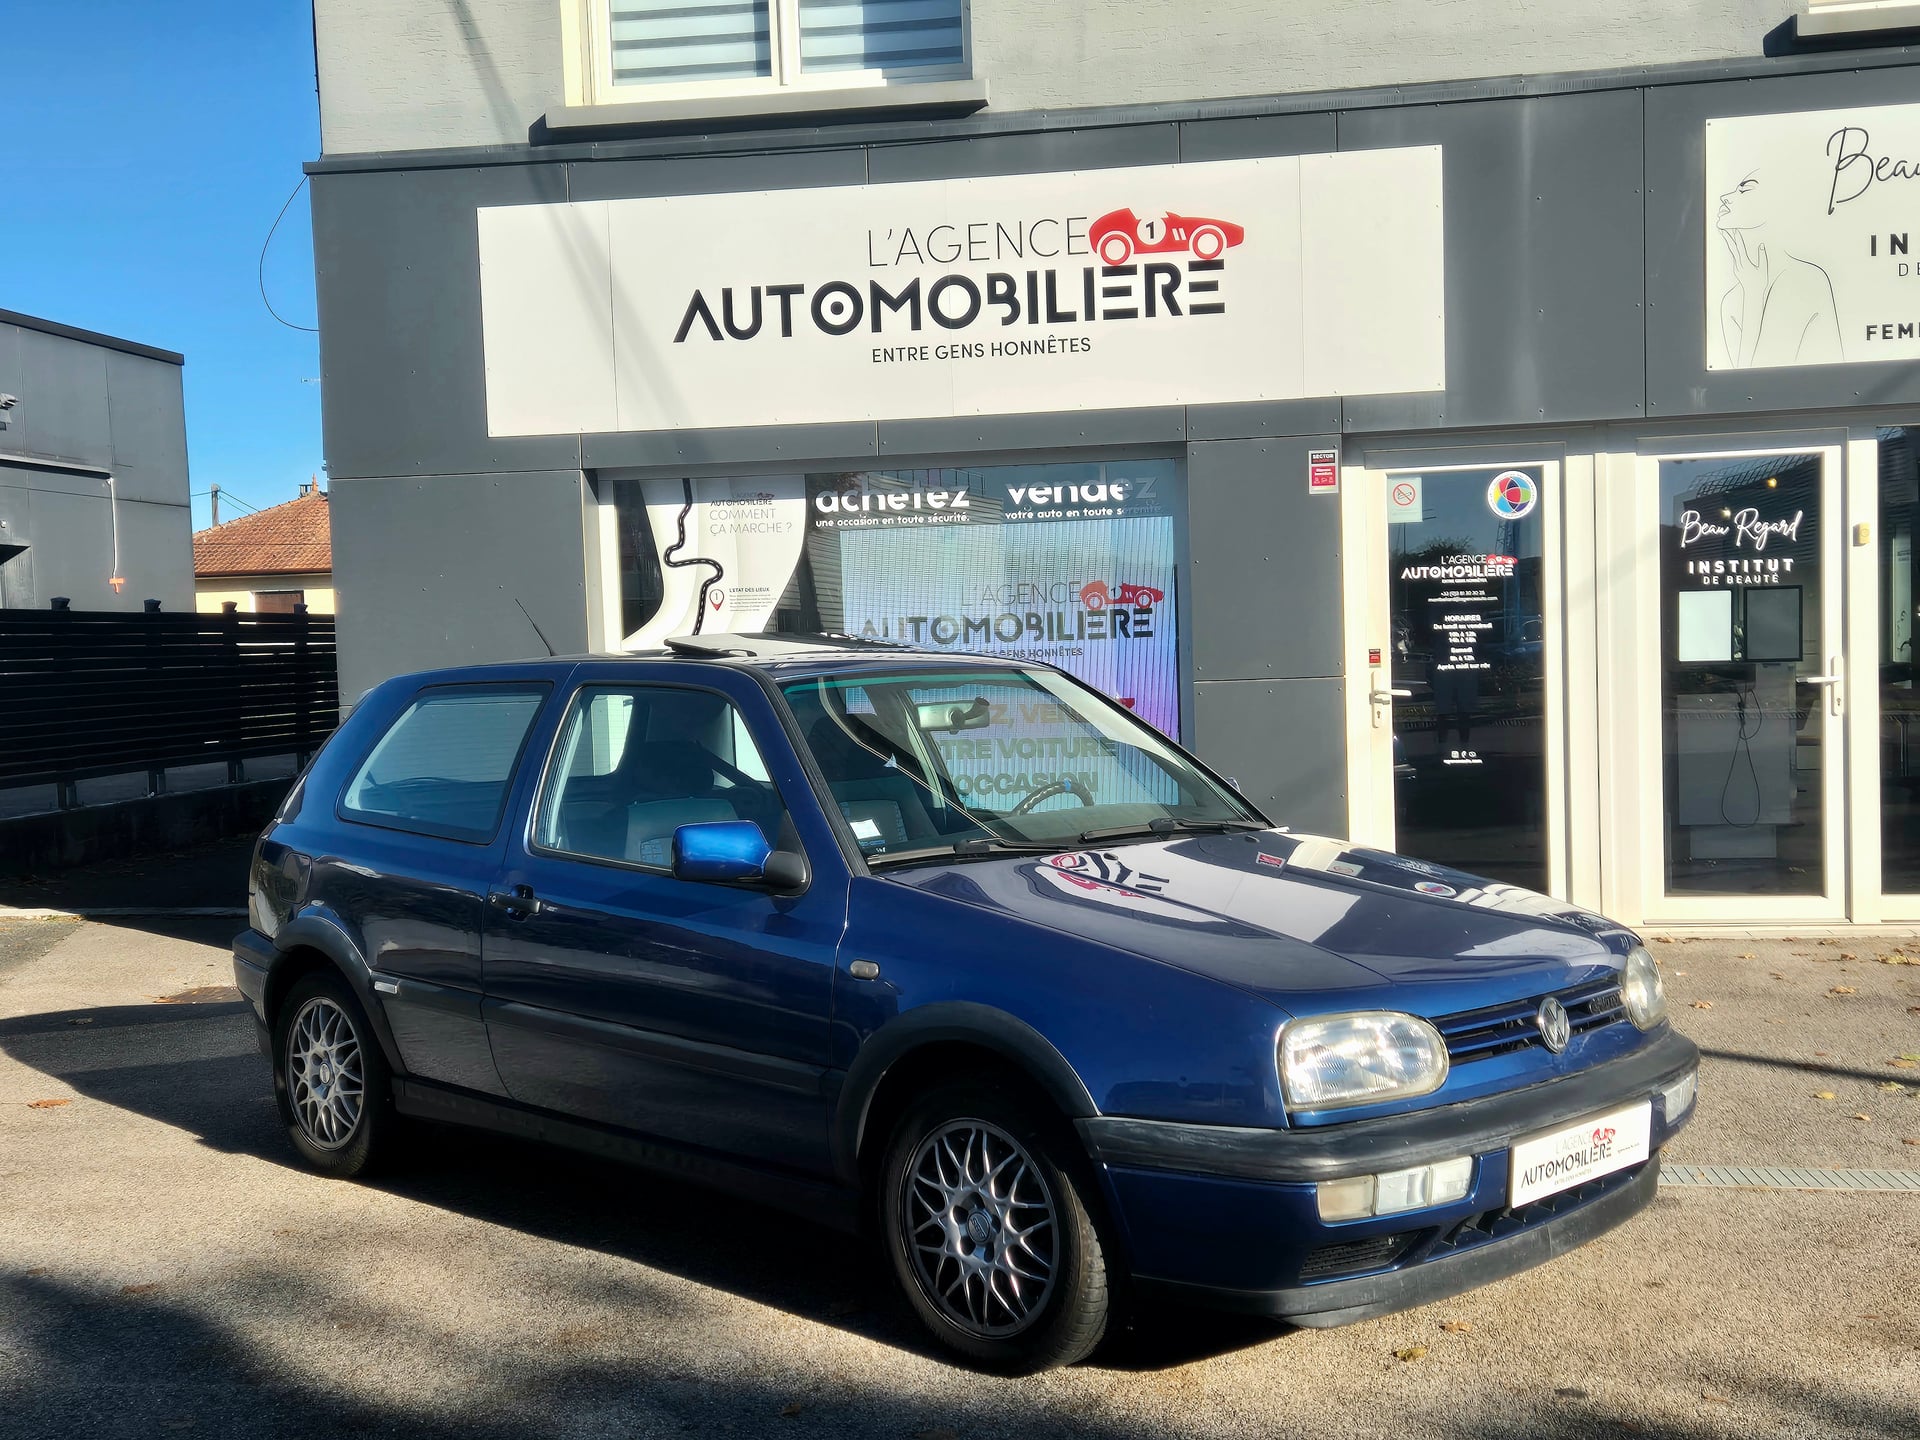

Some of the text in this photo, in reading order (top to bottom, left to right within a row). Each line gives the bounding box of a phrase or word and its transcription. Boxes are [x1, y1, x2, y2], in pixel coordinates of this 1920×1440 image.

[1145, 221, 1155, 240] 1
[868, 216, 1089, 267] L'AGENCE
[1870, 232, 1909, 257] IN
[673, 259, 1226, 343] AUTOMOBILIERE
[872, 334, 1091, 363] ENTRE GENS HONNÊTES
[815, 476, 970, 513] achetez
[1005, 465, 1159, 505] vendez
[709, 508, 776, 521] COMMENT
[816, 519, 834, 527] une
[837, 516, 879, 527] occasion
[898, 514, 924, 524] toute
[1005, 509, 1033, 519] votre
[1037, 508, 1062, 518] auto
[1066, 509, 1080, 518] en
[1083, 506, 1109, 517] toute
[710, 522, 792, 536] ÇA MARCHE ?
[1680, 507, 1803, 551] Beau Regard
[1441, 554, 1487, 565] L'AGENCE
[1688, 558, 1794, 575] INSTITUT
[1401, 564, 1514, 579] AUTOMOBILIERE
[1703, 573, 1779, 585] DE BEAUTÉ
[940, 738, 992, 759] TRE
